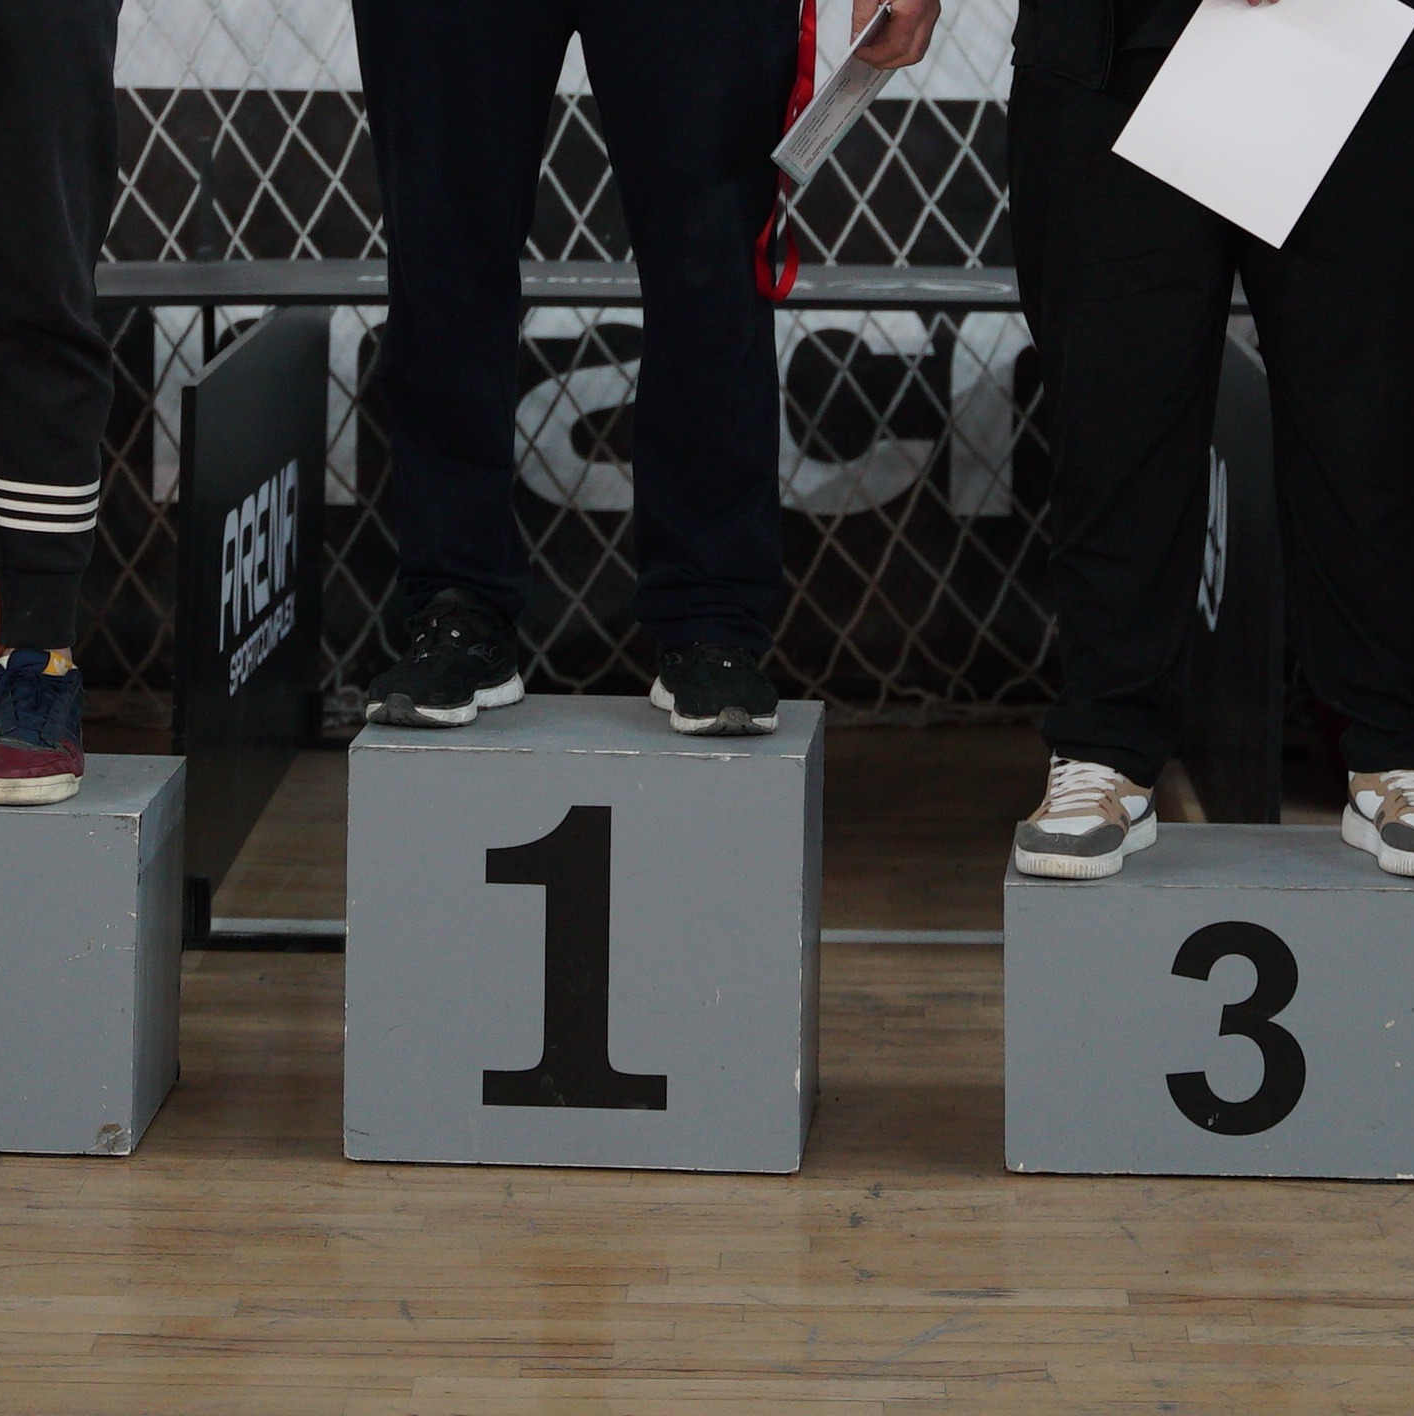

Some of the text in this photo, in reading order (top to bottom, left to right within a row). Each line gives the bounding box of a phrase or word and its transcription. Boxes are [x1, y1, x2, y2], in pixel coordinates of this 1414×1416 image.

[218, 457, 299, 654] ARENA
[480, 803, 669, 1113] 1
[1163, 920, 1308, 1138] 3
